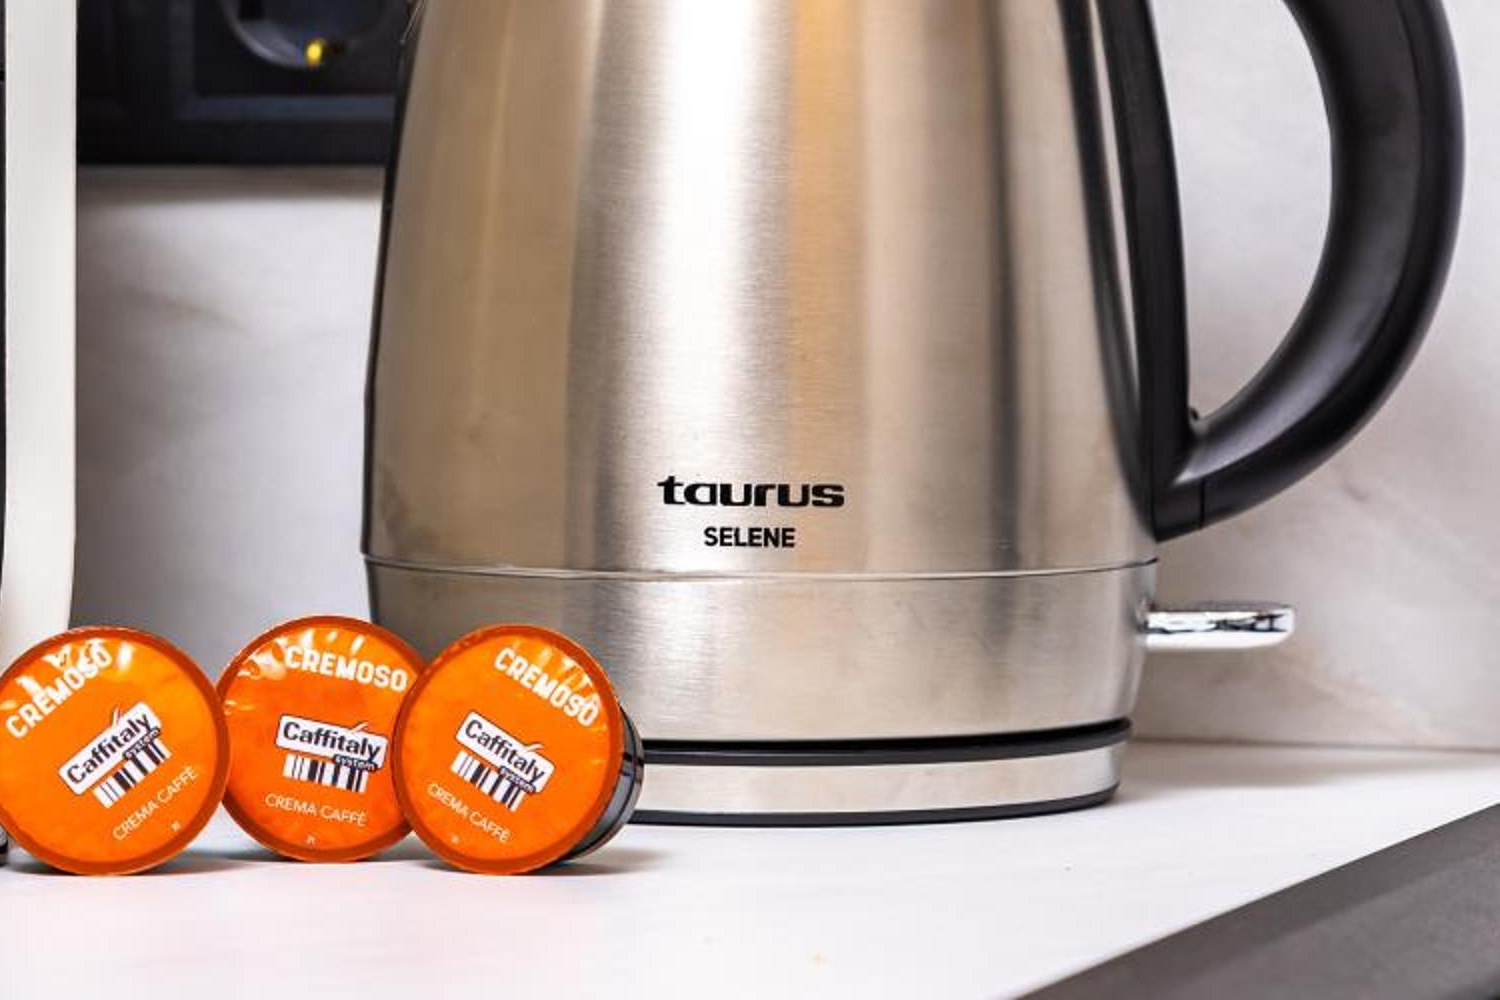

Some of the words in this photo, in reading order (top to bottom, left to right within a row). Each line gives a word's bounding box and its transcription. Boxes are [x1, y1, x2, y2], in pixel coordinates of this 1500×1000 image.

[658, 475, 845, 508] taurus
[704, 527, 796, 549] SELENE
[5, 638, 114, 739] CREMOSO
[285, 646, 408, 692] CREMOSO
[493, 646, 602, 728] CREMOSO
[65, 712, 152, 785] Caffitaly
[283, 720, 382, 765] Caffitaly
[464, 718, 546, 785] Caffitaly
[113, 801, 160, 841] CREMA
[265, 793, 317, 817] CREMA
[427, 782, 470, 819] CREMA
